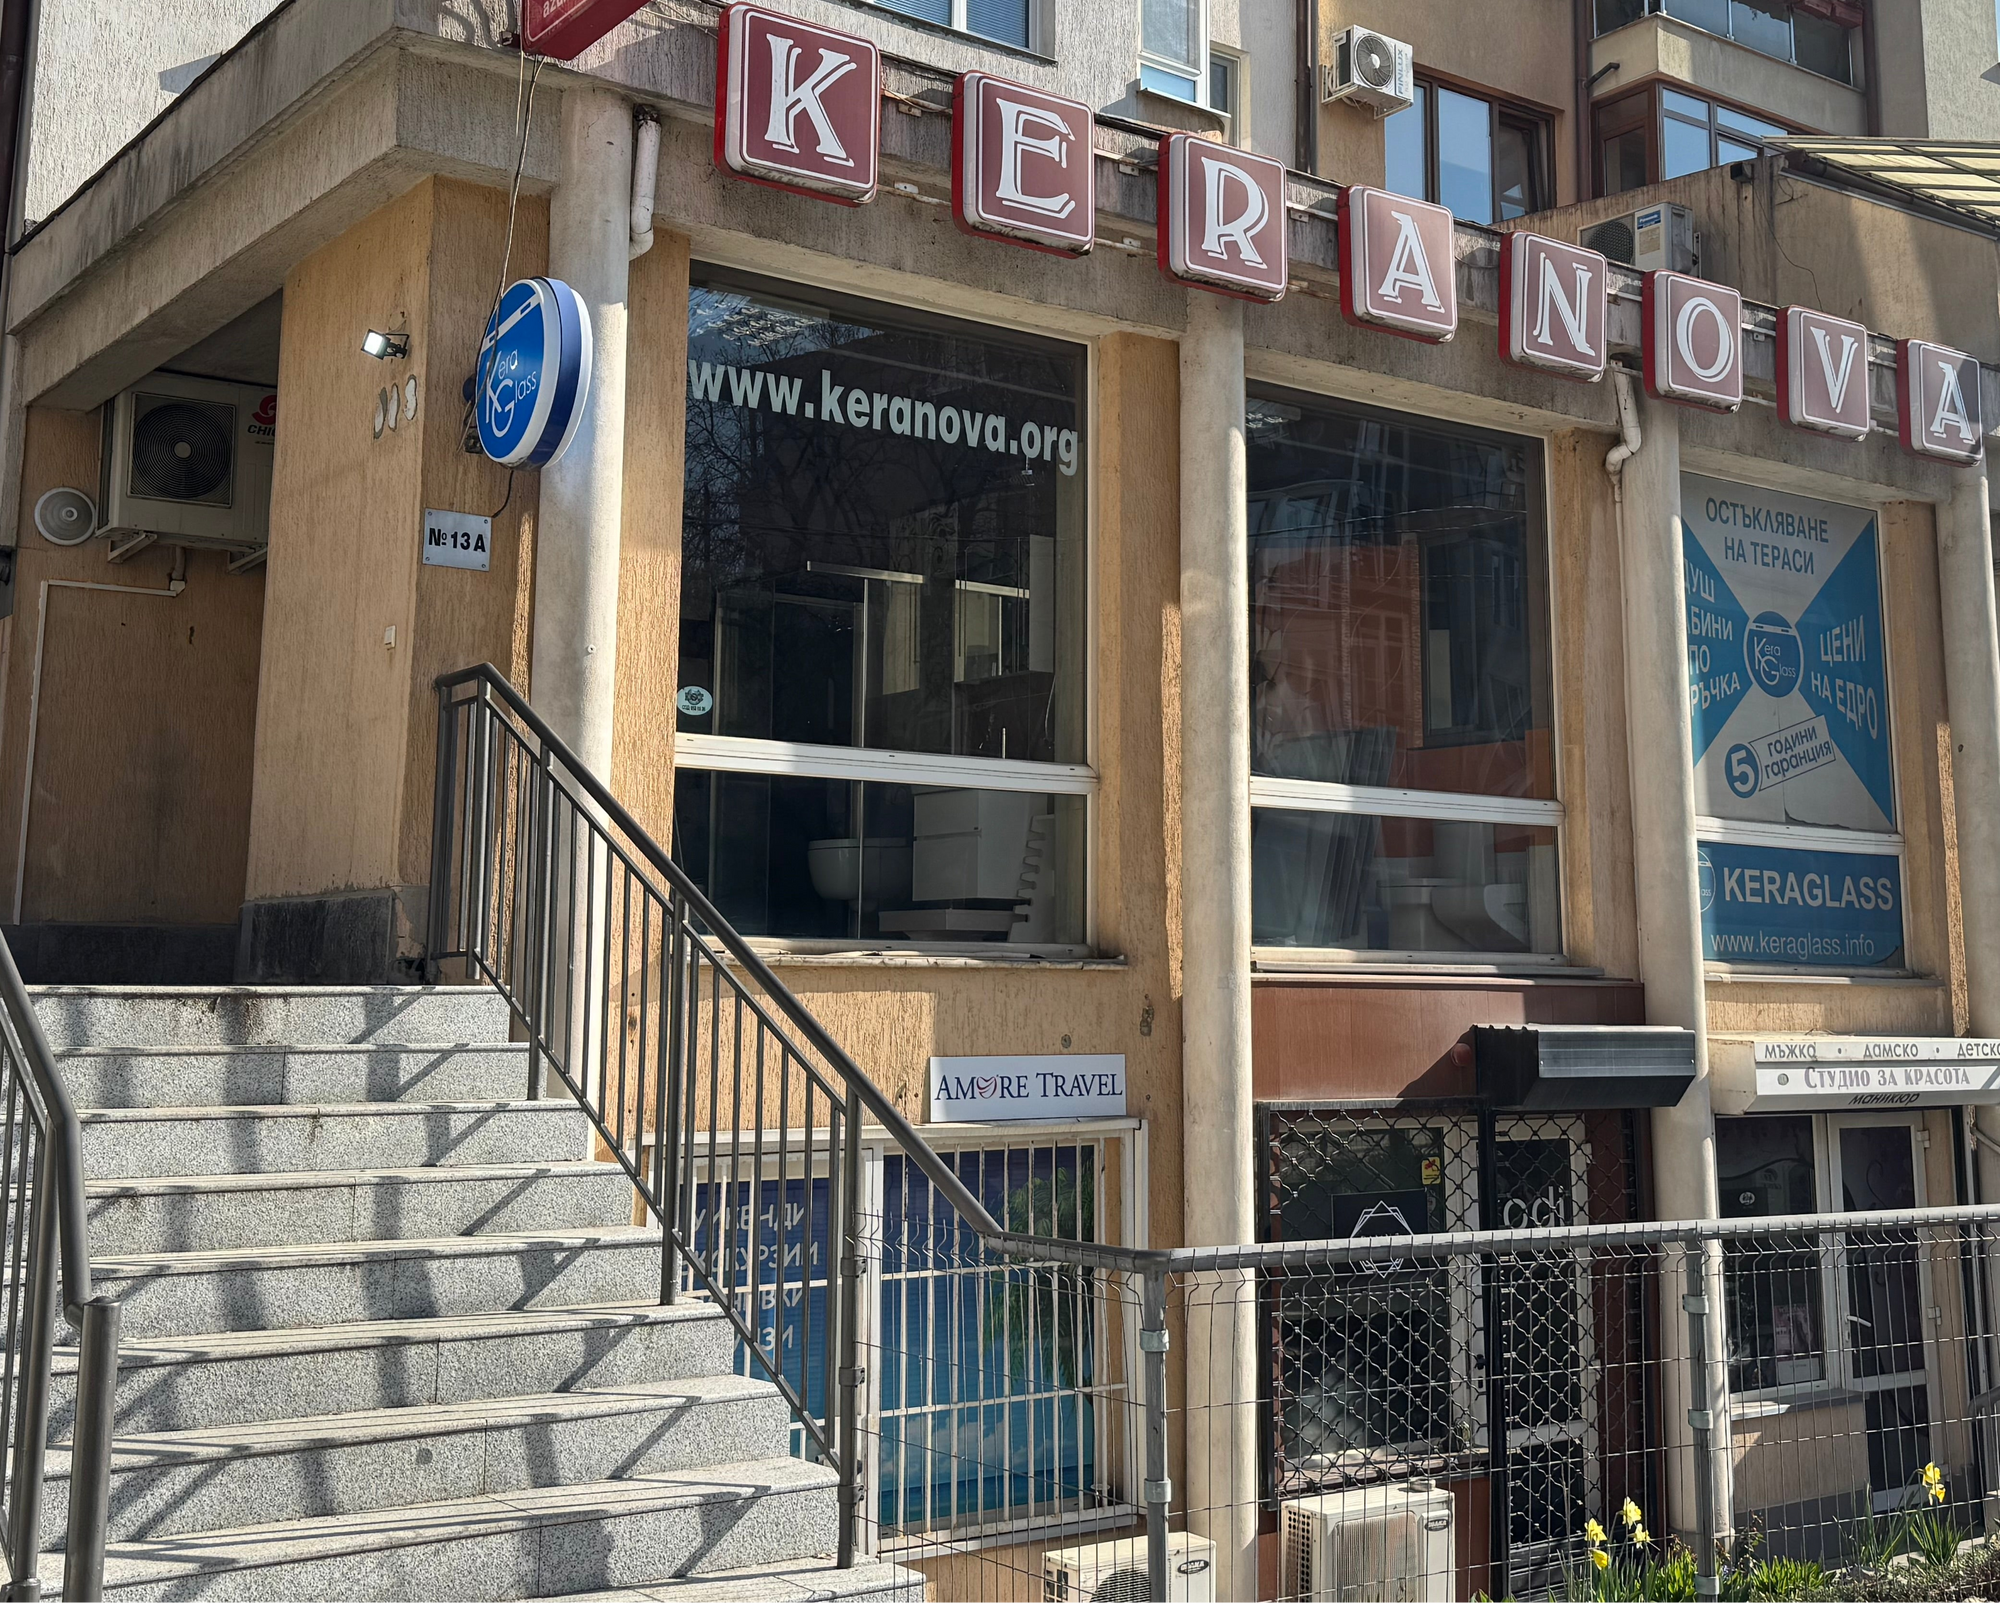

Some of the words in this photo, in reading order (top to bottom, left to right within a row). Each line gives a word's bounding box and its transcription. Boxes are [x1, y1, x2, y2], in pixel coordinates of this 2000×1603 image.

[764, 33, 1975, 444] KERANOVA
[688, 359, 1079, 477] www.keranova.org
[1705, 496, 1830, 544] ОСТЪКЛЯВАНЕ
[1723, 536, 1747, 563] НА
[1750, 541, 1815, 575] ТЕРАСИ
[1688, 644, 1711, 676] ПО
[1820, 614, 1866, 667] ЦЕНИ
[1811, 670, 1833, 705] НА
[1835, 678, 1878, 740] ЕДРО
[1730, 748, 1756, 793] 5
[1764, 740, 1833, 780] гаранция
[1723, 867, 1894, 911] KERAGLASS
[1710, 930, 1875, 960] www.keraglass.info
[1863, 1043, 1919, 1059] дамско
[1848, 1091, 1921, 1106] маникюр
